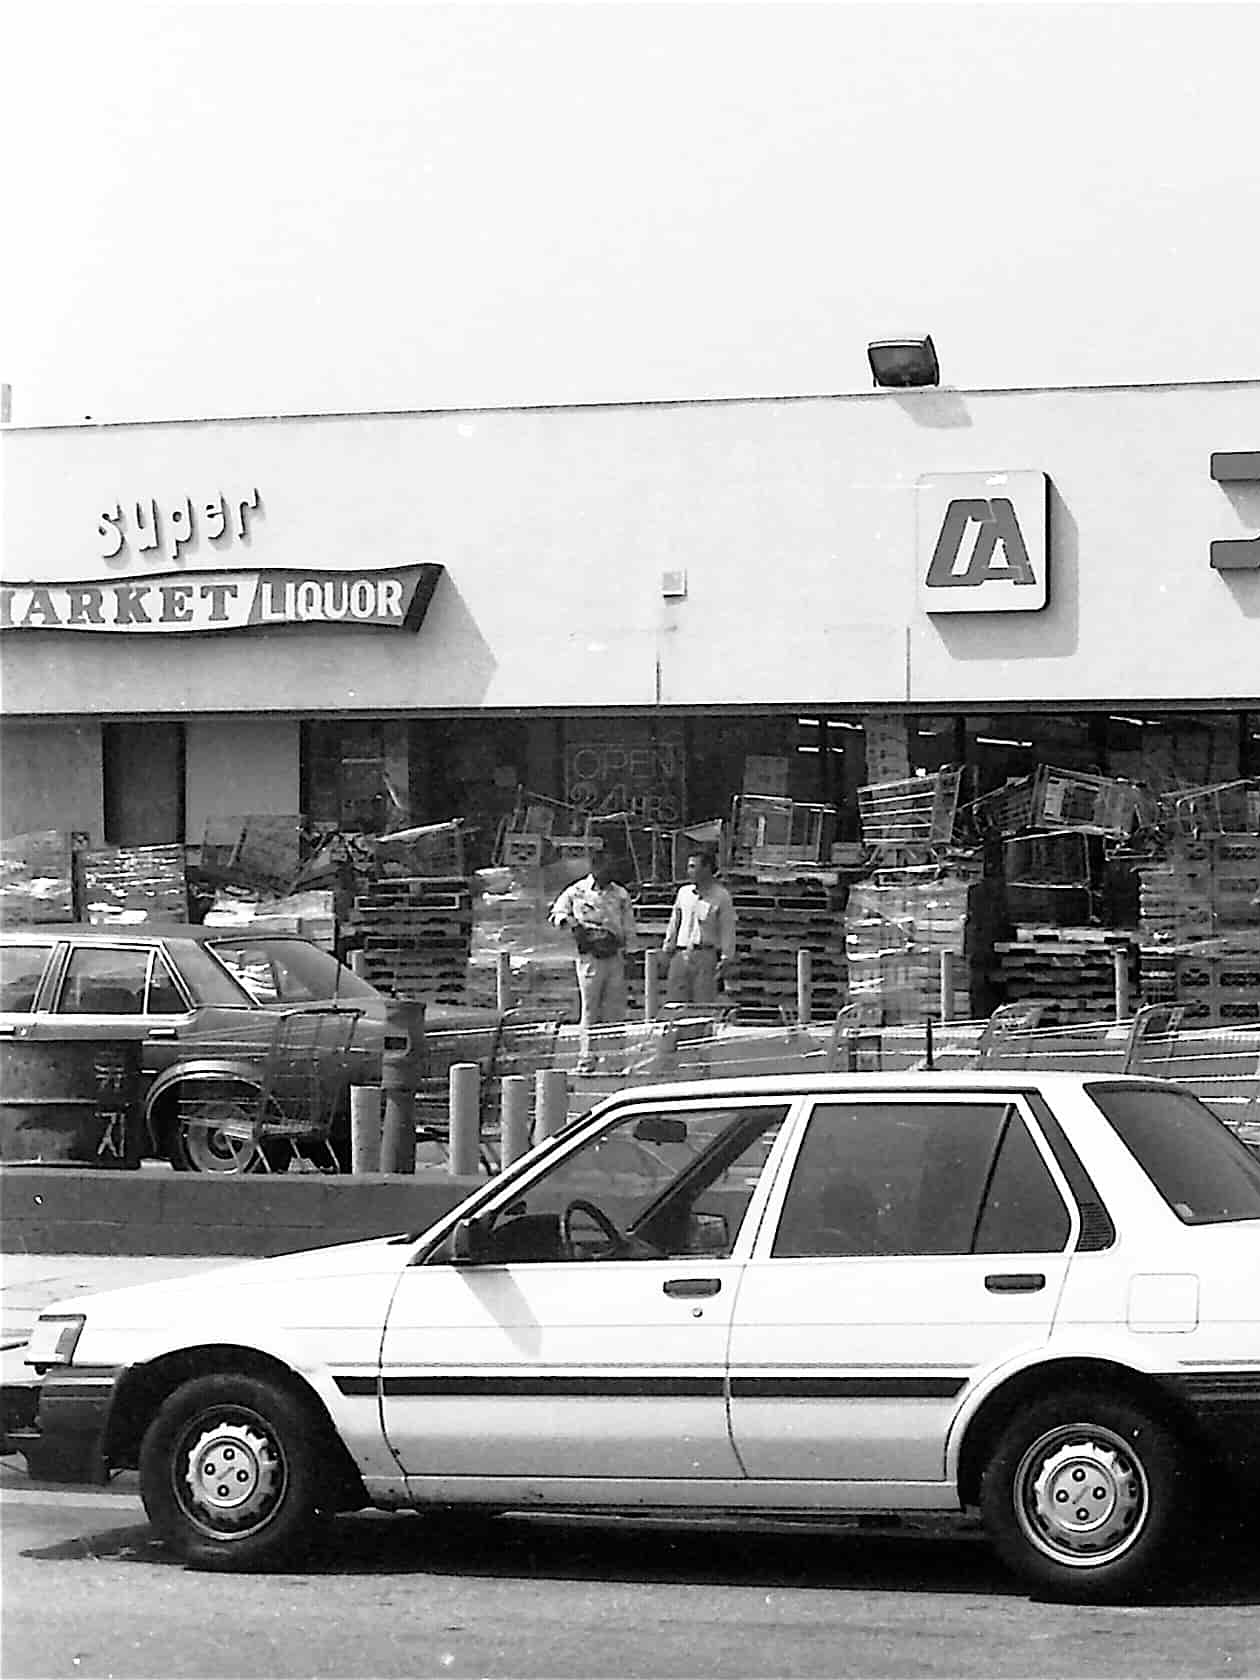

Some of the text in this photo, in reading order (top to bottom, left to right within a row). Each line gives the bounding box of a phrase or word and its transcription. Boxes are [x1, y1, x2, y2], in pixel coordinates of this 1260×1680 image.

[261, 579, 404, 621] LIQUOR
[573, 749, 675, 780] OPEN
[570, 782, 628, 812] 24
